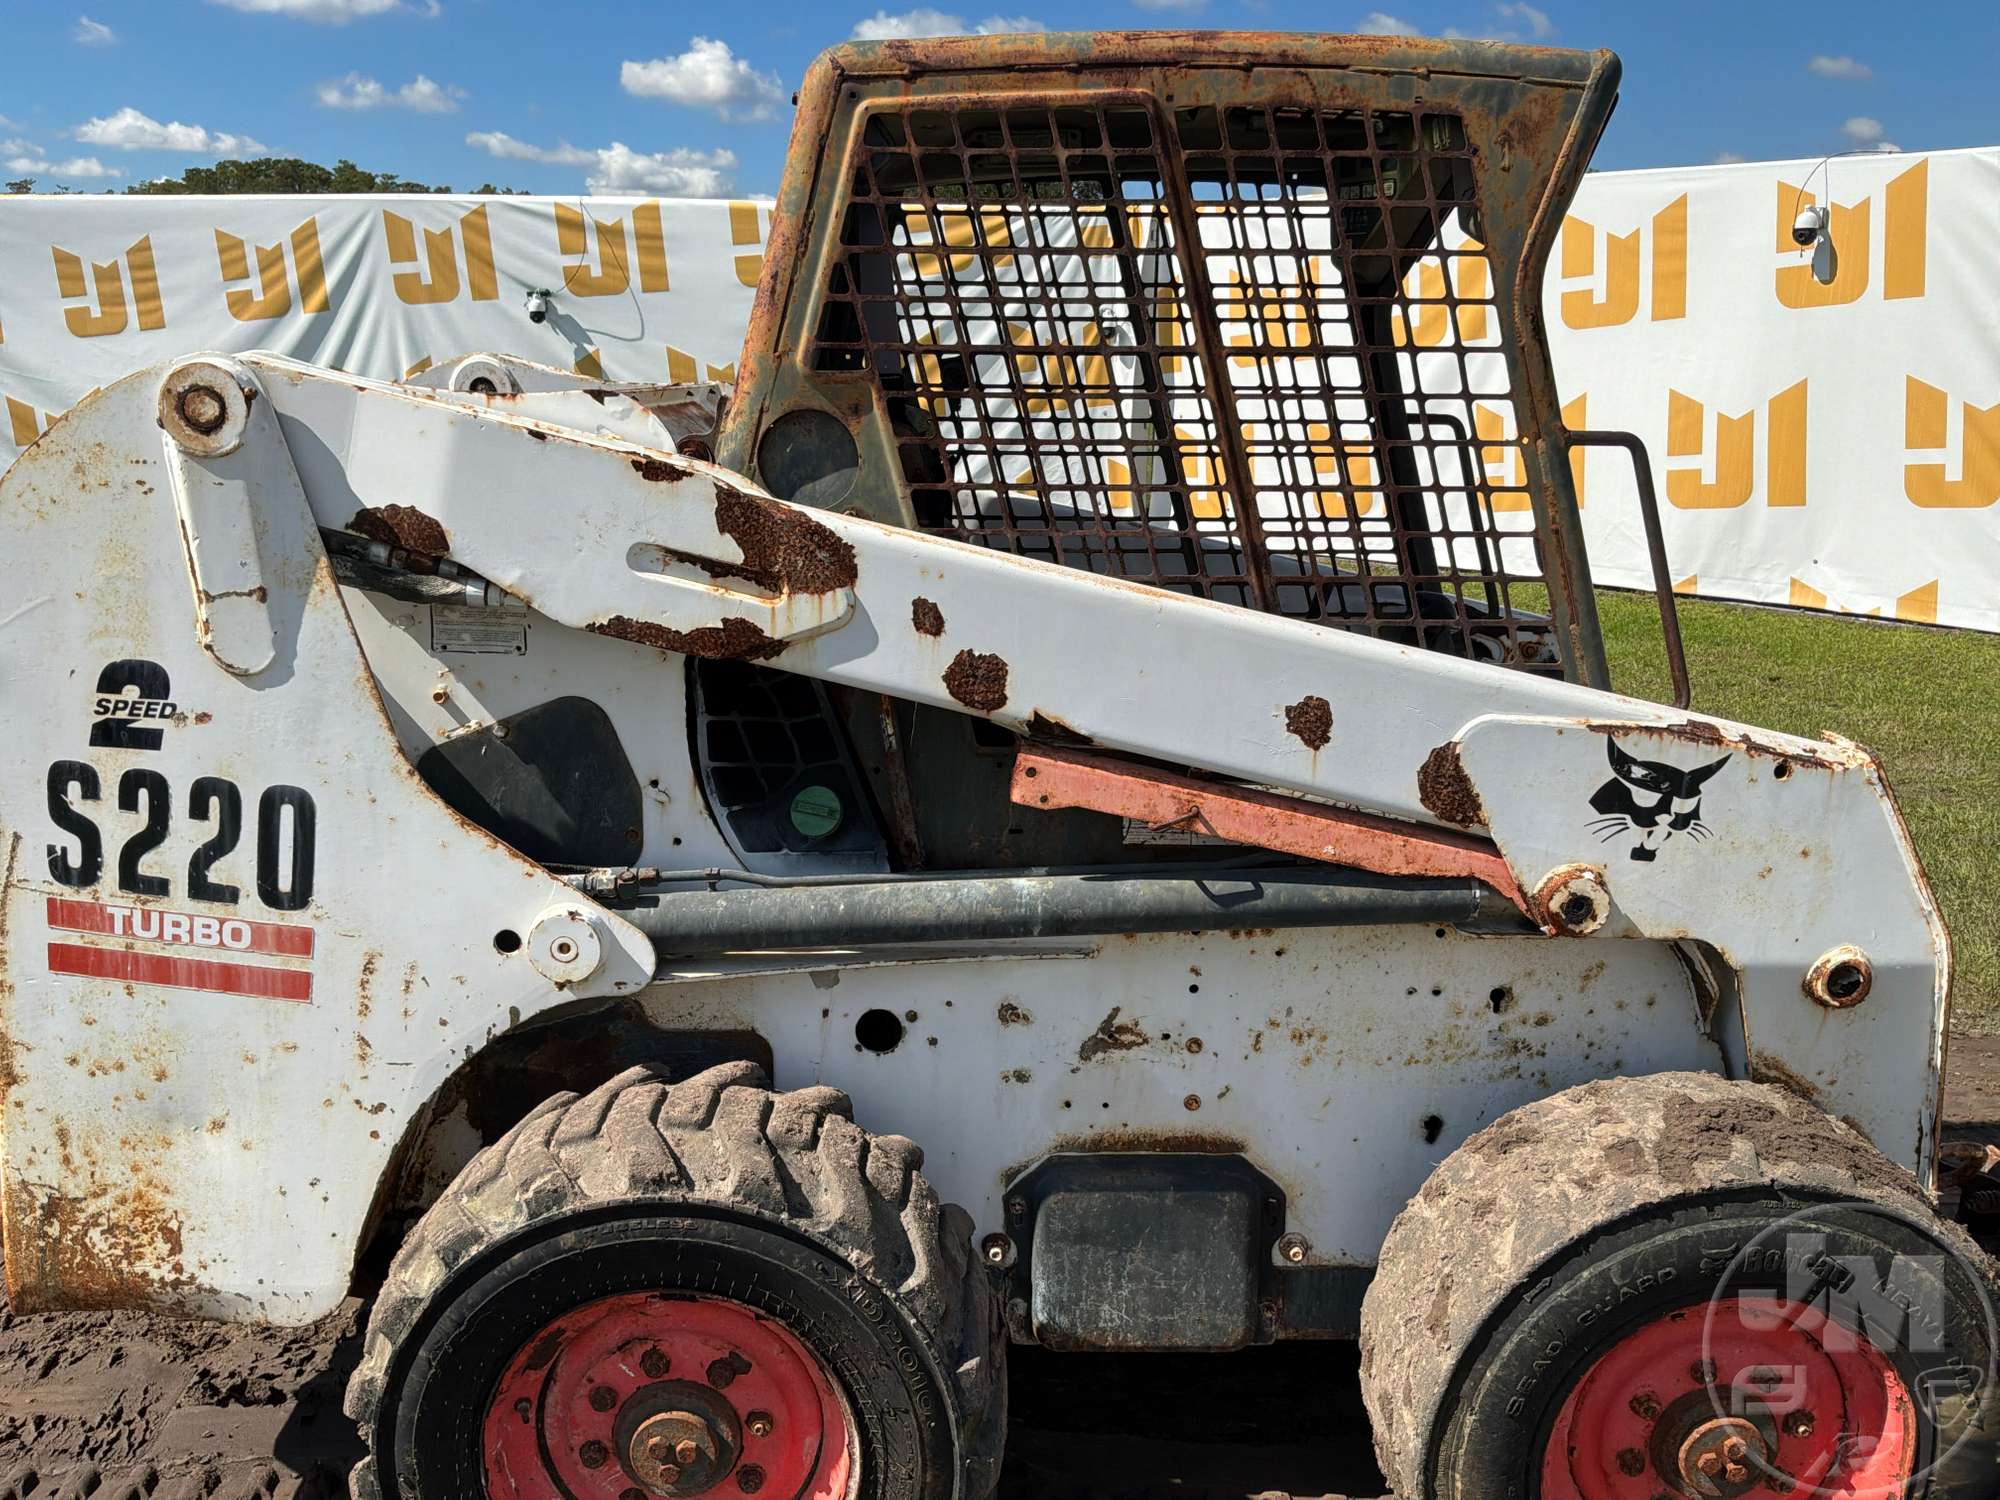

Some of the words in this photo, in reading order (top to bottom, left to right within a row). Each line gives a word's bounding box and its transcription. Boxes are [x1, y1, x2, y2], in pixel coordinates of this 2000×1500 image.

[94, 699, 177, 719] SPEED
[47, 759, 317, 912] S220
[106, 905, 252, 950] TURBO
